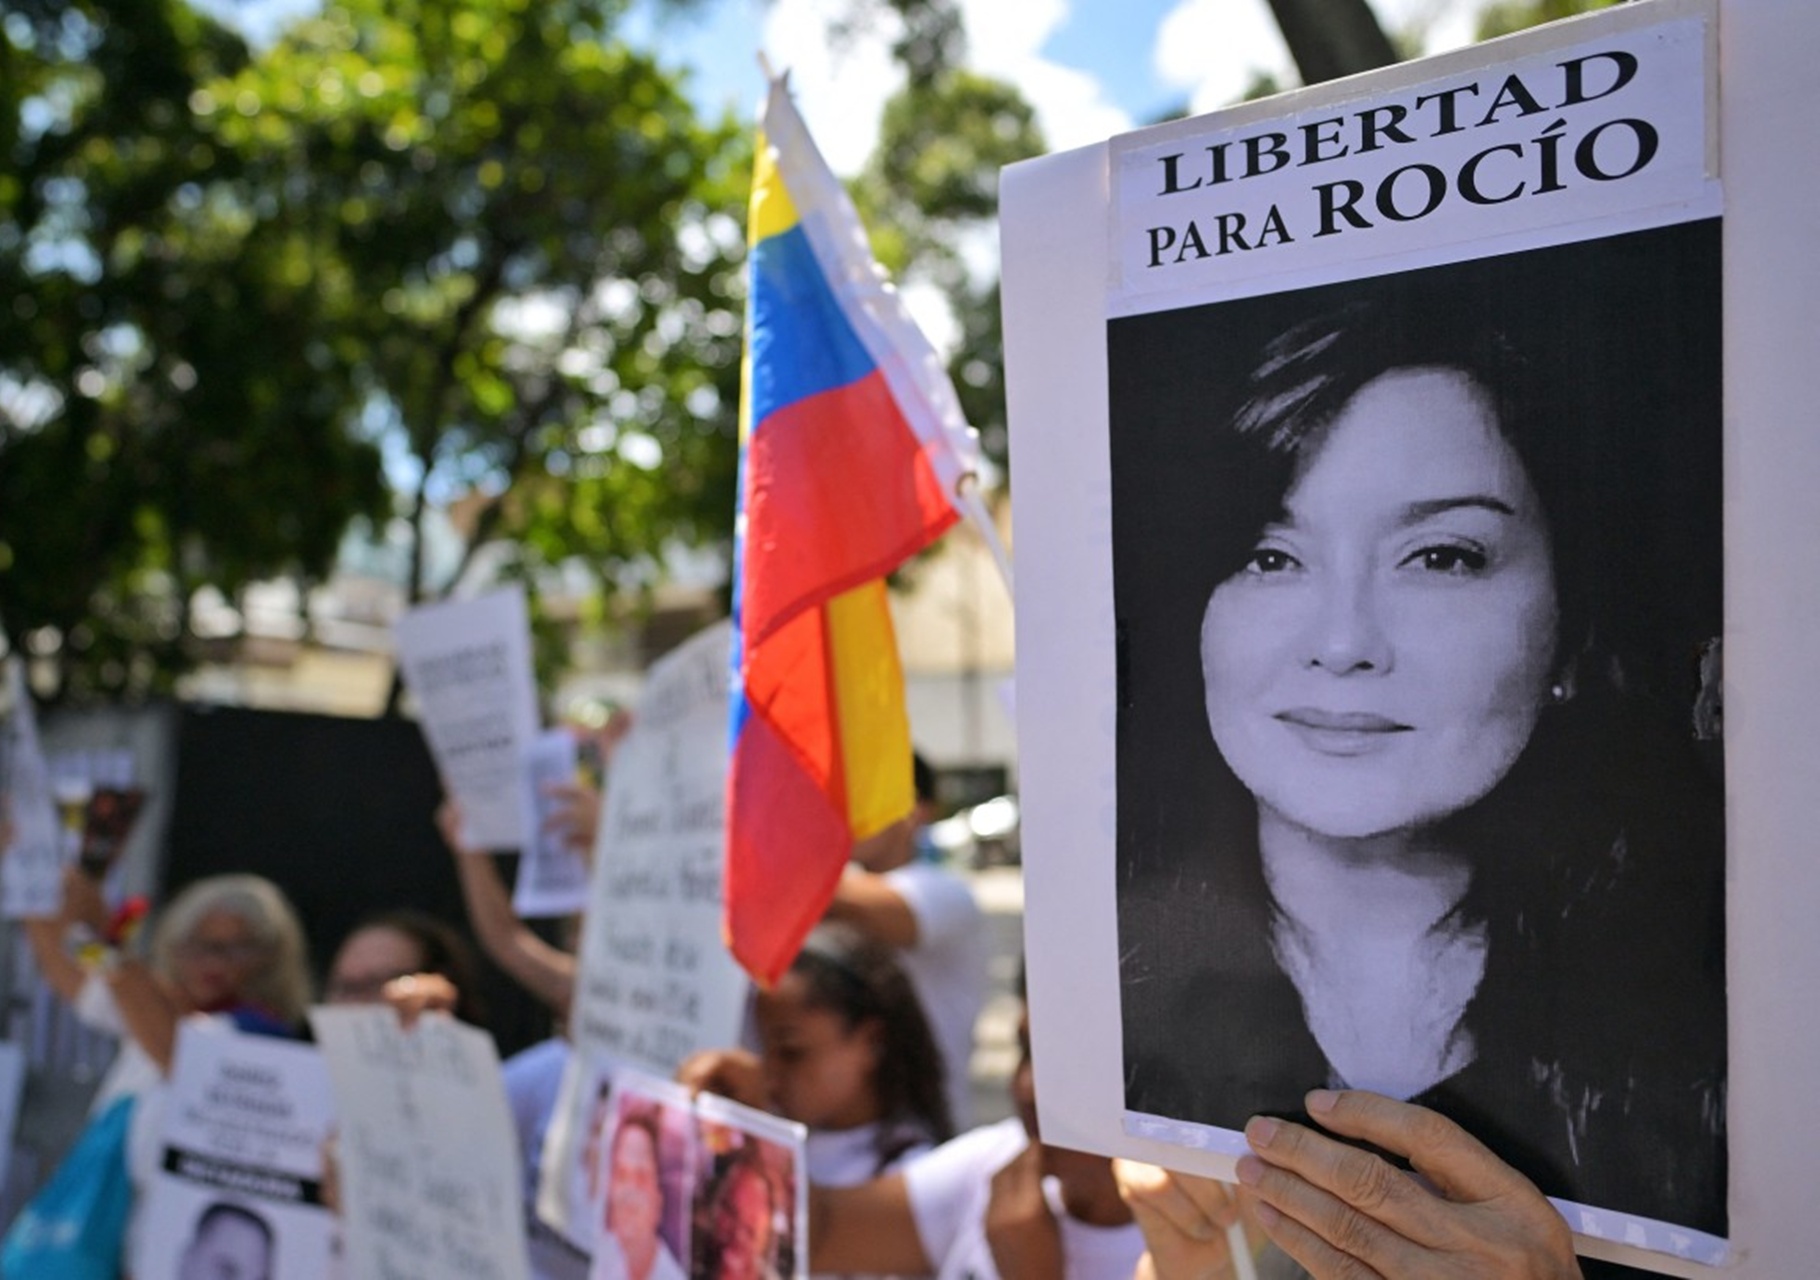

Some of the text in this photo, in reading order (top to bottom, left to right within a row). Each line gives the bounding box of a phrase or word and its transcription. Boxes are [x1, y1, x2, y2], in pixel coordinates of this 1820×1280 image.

[1146, 117, 1660, 268] PARA ROCÍO
[1157, 50, 1639, 196] LIBERTAD
